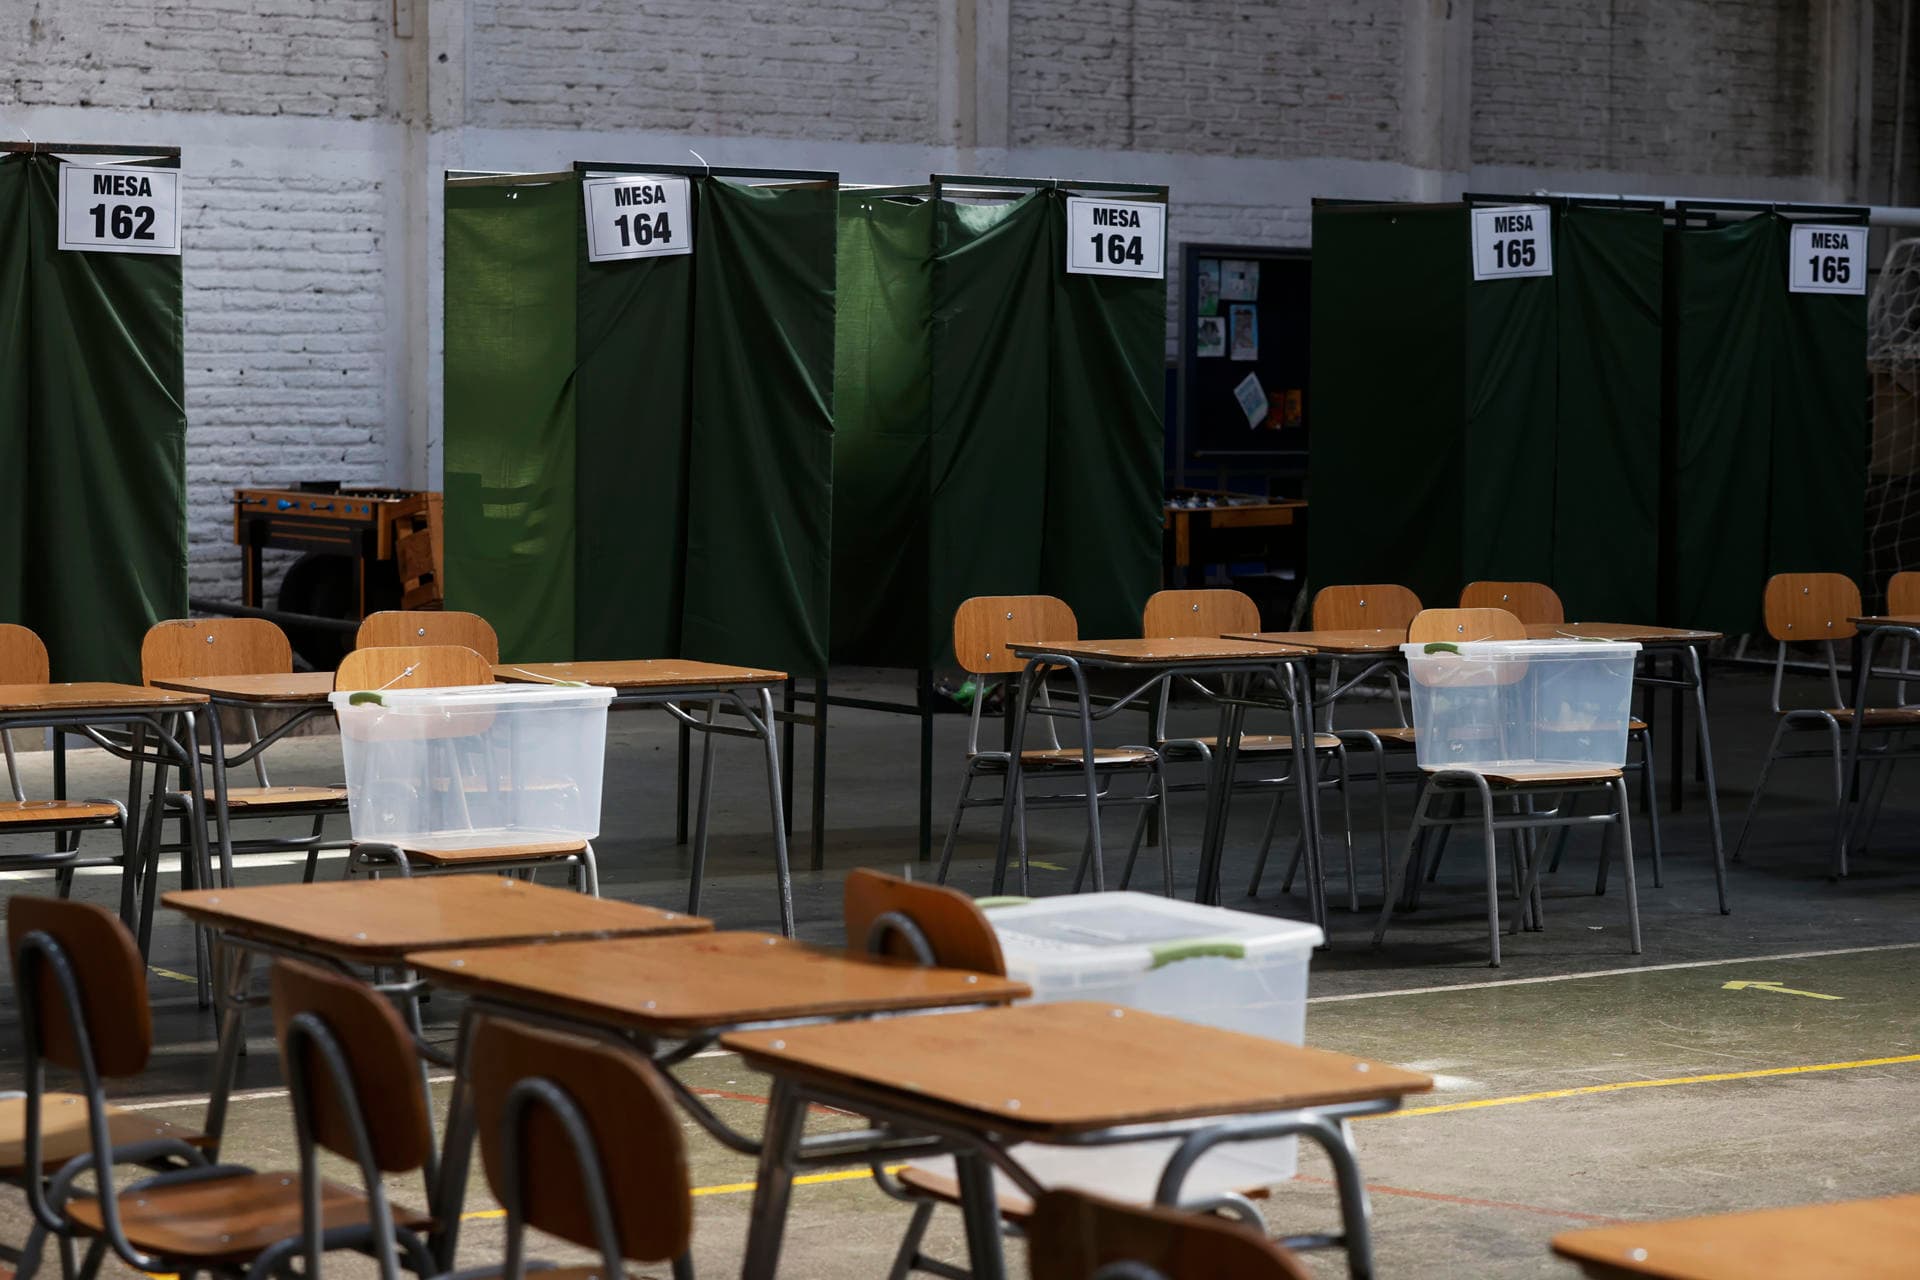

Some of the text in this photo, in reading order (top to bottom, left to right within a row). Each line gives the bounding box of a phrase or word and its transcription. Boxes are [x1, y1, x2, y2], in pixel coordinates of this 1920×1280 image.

[94, 174, 151, 197] MESA
[614, 185, 666, 206] MESA
[90, 203, 154, 240] 162
[615, 212, 671, 247] 164
[1093, 208, 1140, 228] MESA
[1495, 215, 1533, 233] MESA
[1091, 233, 1143, 265] 164
[1494, 239, 1535, 268] 165
[1812, 233, 1848, 250] MESA
[1809, 256, 1850, 283] 165
